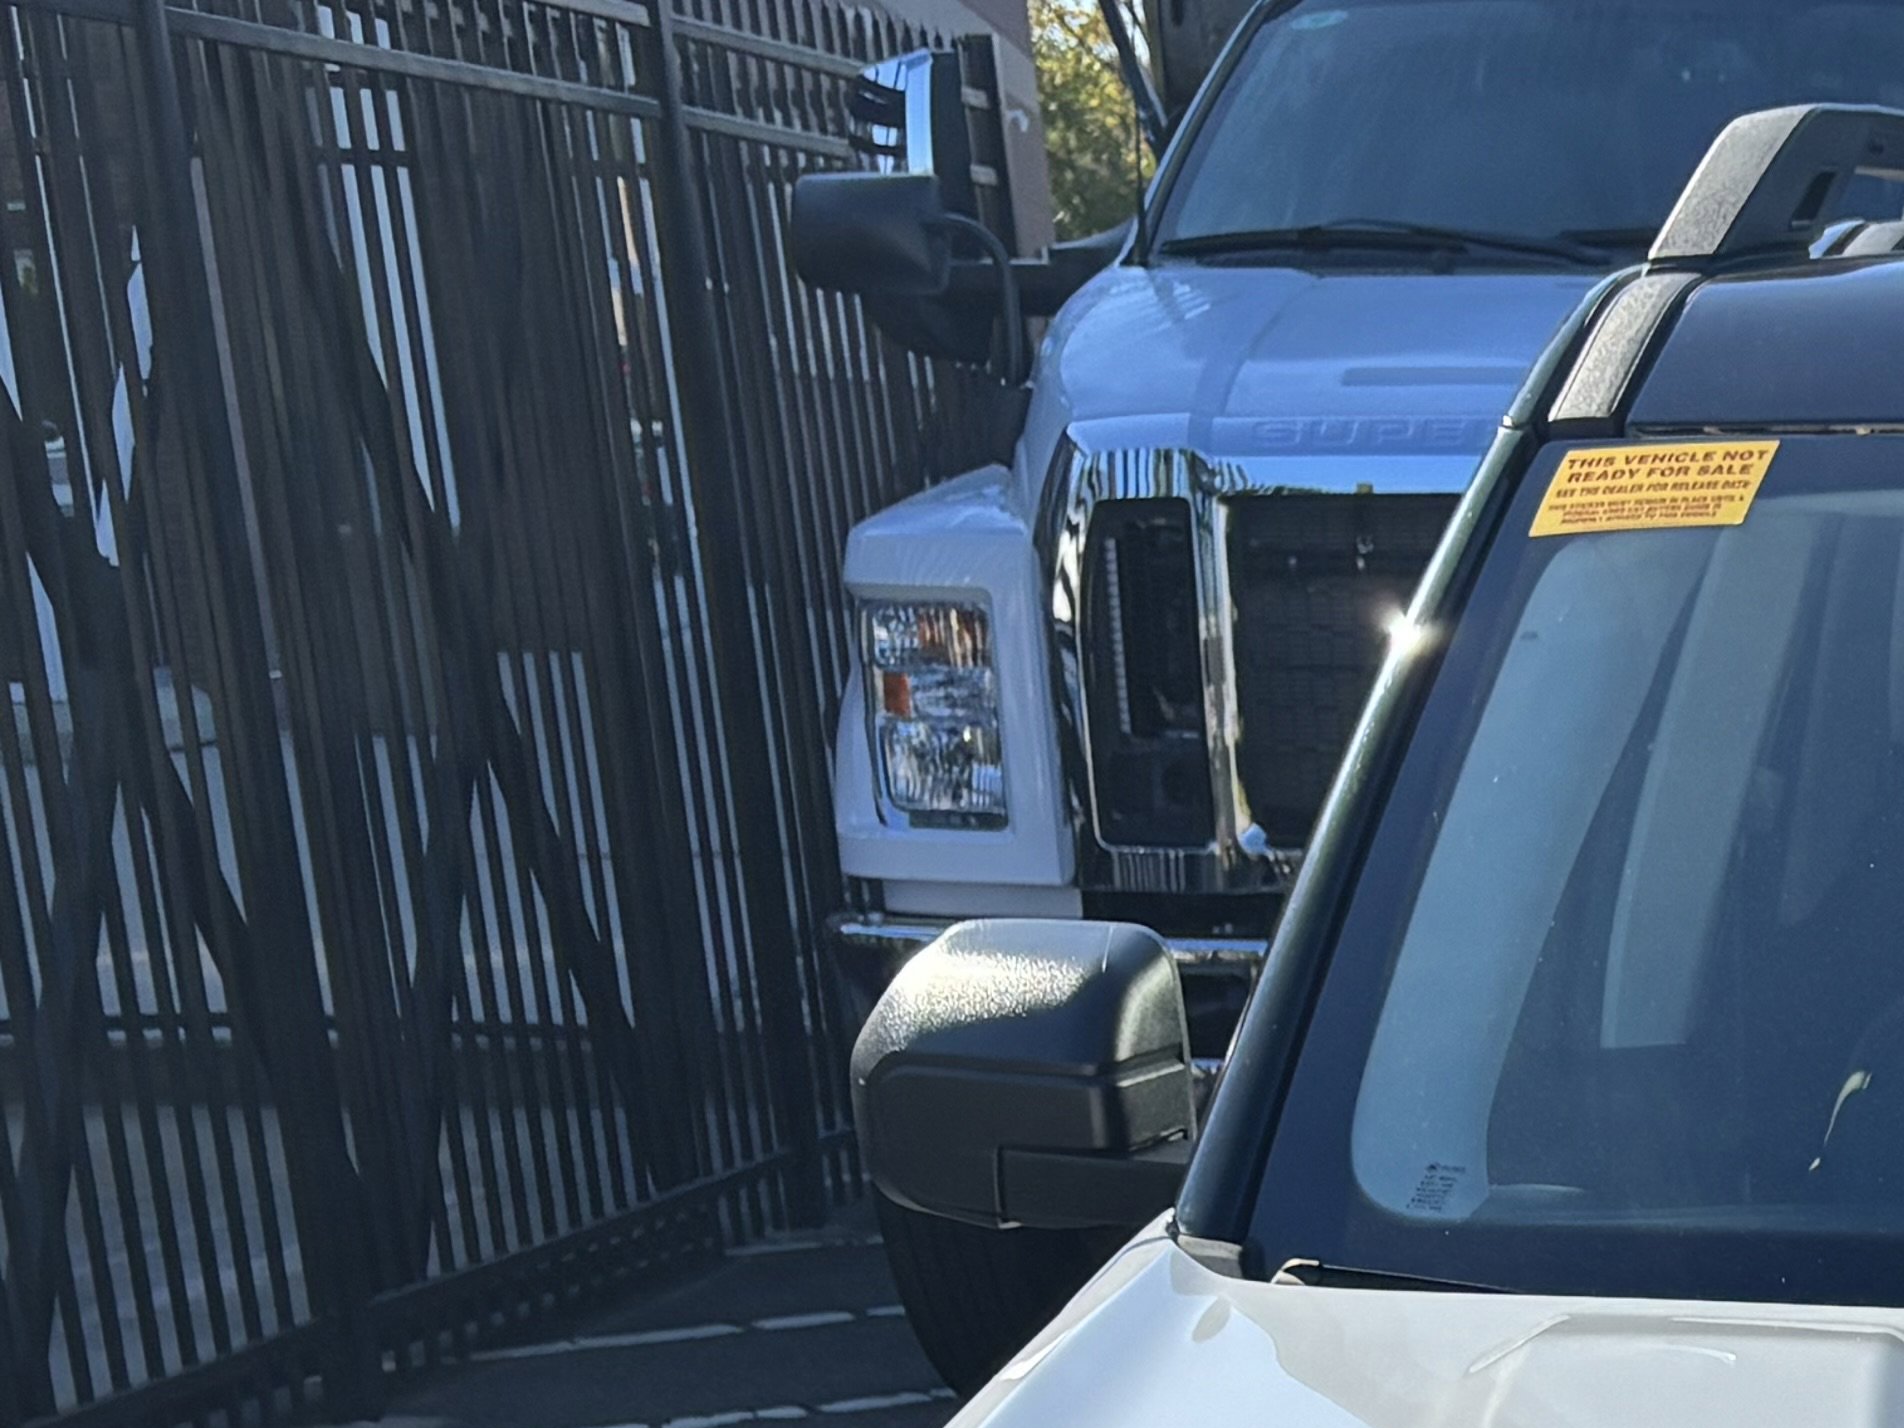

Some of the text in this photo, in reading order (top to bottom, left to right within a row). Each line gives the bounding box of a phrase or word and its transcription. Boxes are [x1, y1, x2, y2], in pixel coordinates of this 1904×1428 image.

[1568, 449, 1769, 470] THIS VEHICLE NOT
[1567, 463, 1754, 483] READY FOR SALE
